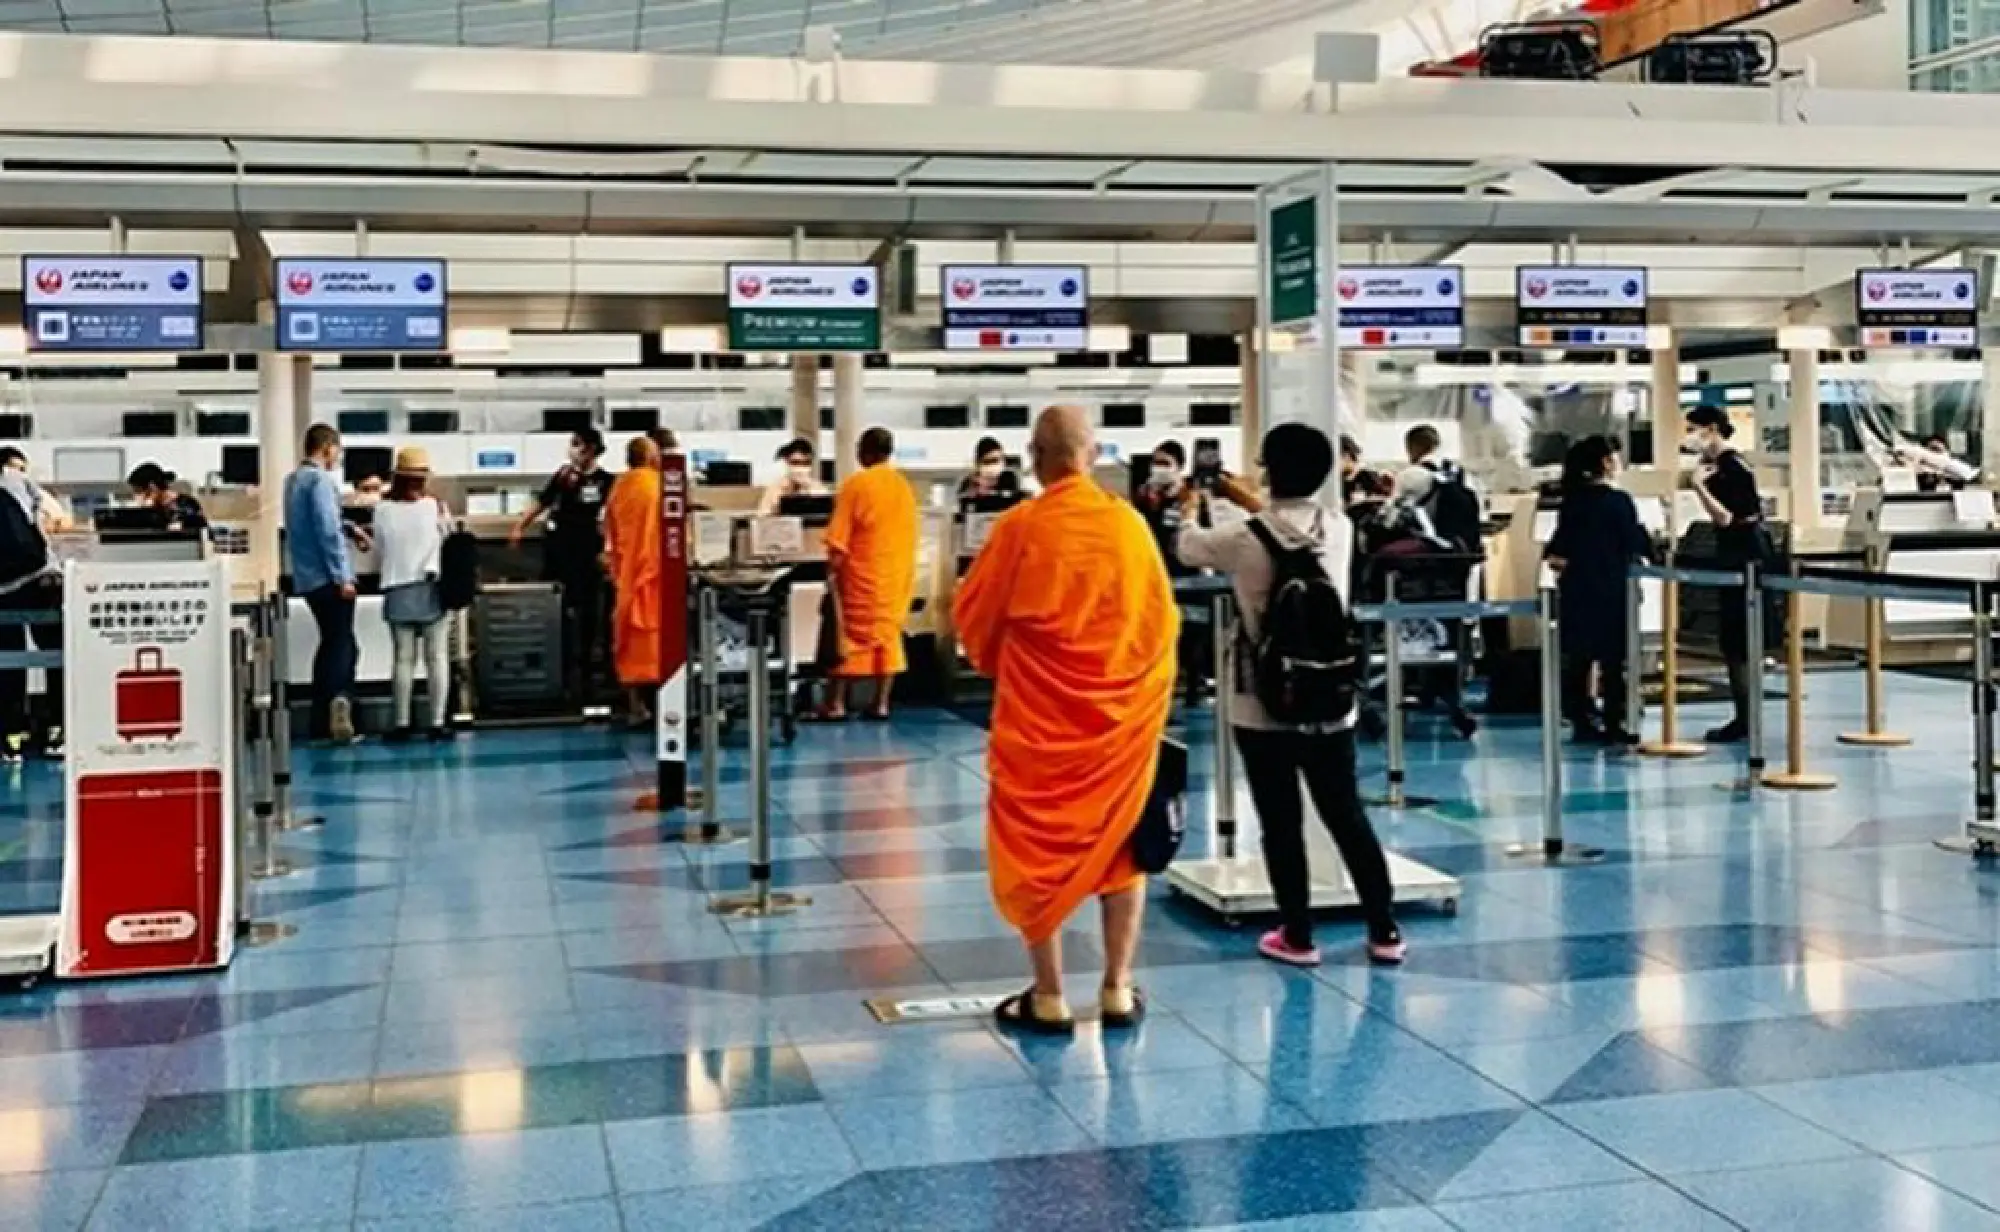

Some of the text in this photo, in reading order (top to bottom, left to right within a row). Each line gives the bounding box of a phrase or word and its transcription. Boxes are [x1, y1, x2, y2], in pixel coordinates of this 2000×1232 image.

[71, 269, 123, 281] JAPAN
[72, 281, 149, 291] AIRLINES
[104, 579, 210, 592] JAPAN AIRLINES
